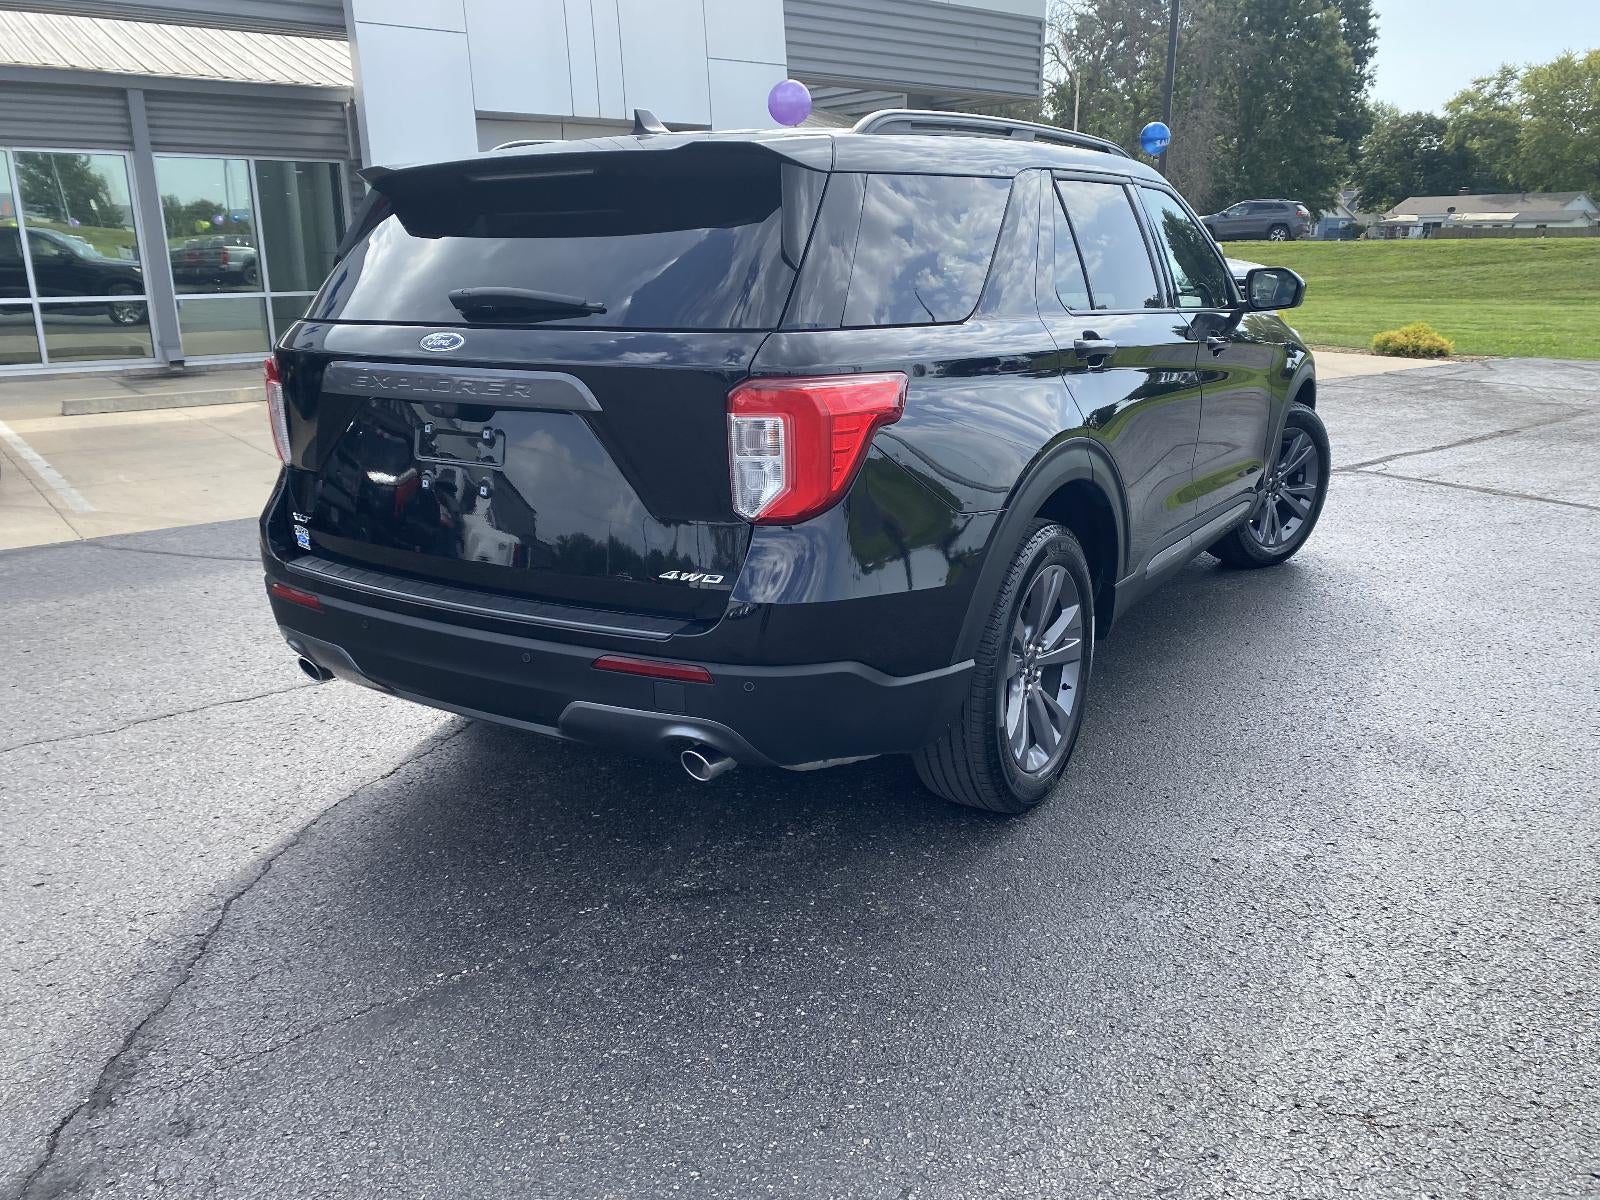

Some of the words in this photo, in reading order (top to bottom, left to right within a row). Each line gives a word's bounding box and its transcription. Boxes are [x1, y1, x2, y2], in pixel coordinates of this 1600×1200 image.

[424, 334, 457, 348] Ford
[351, 375, 532, 398] EXPLORER
[658, 569, 725, 584] 4WD
